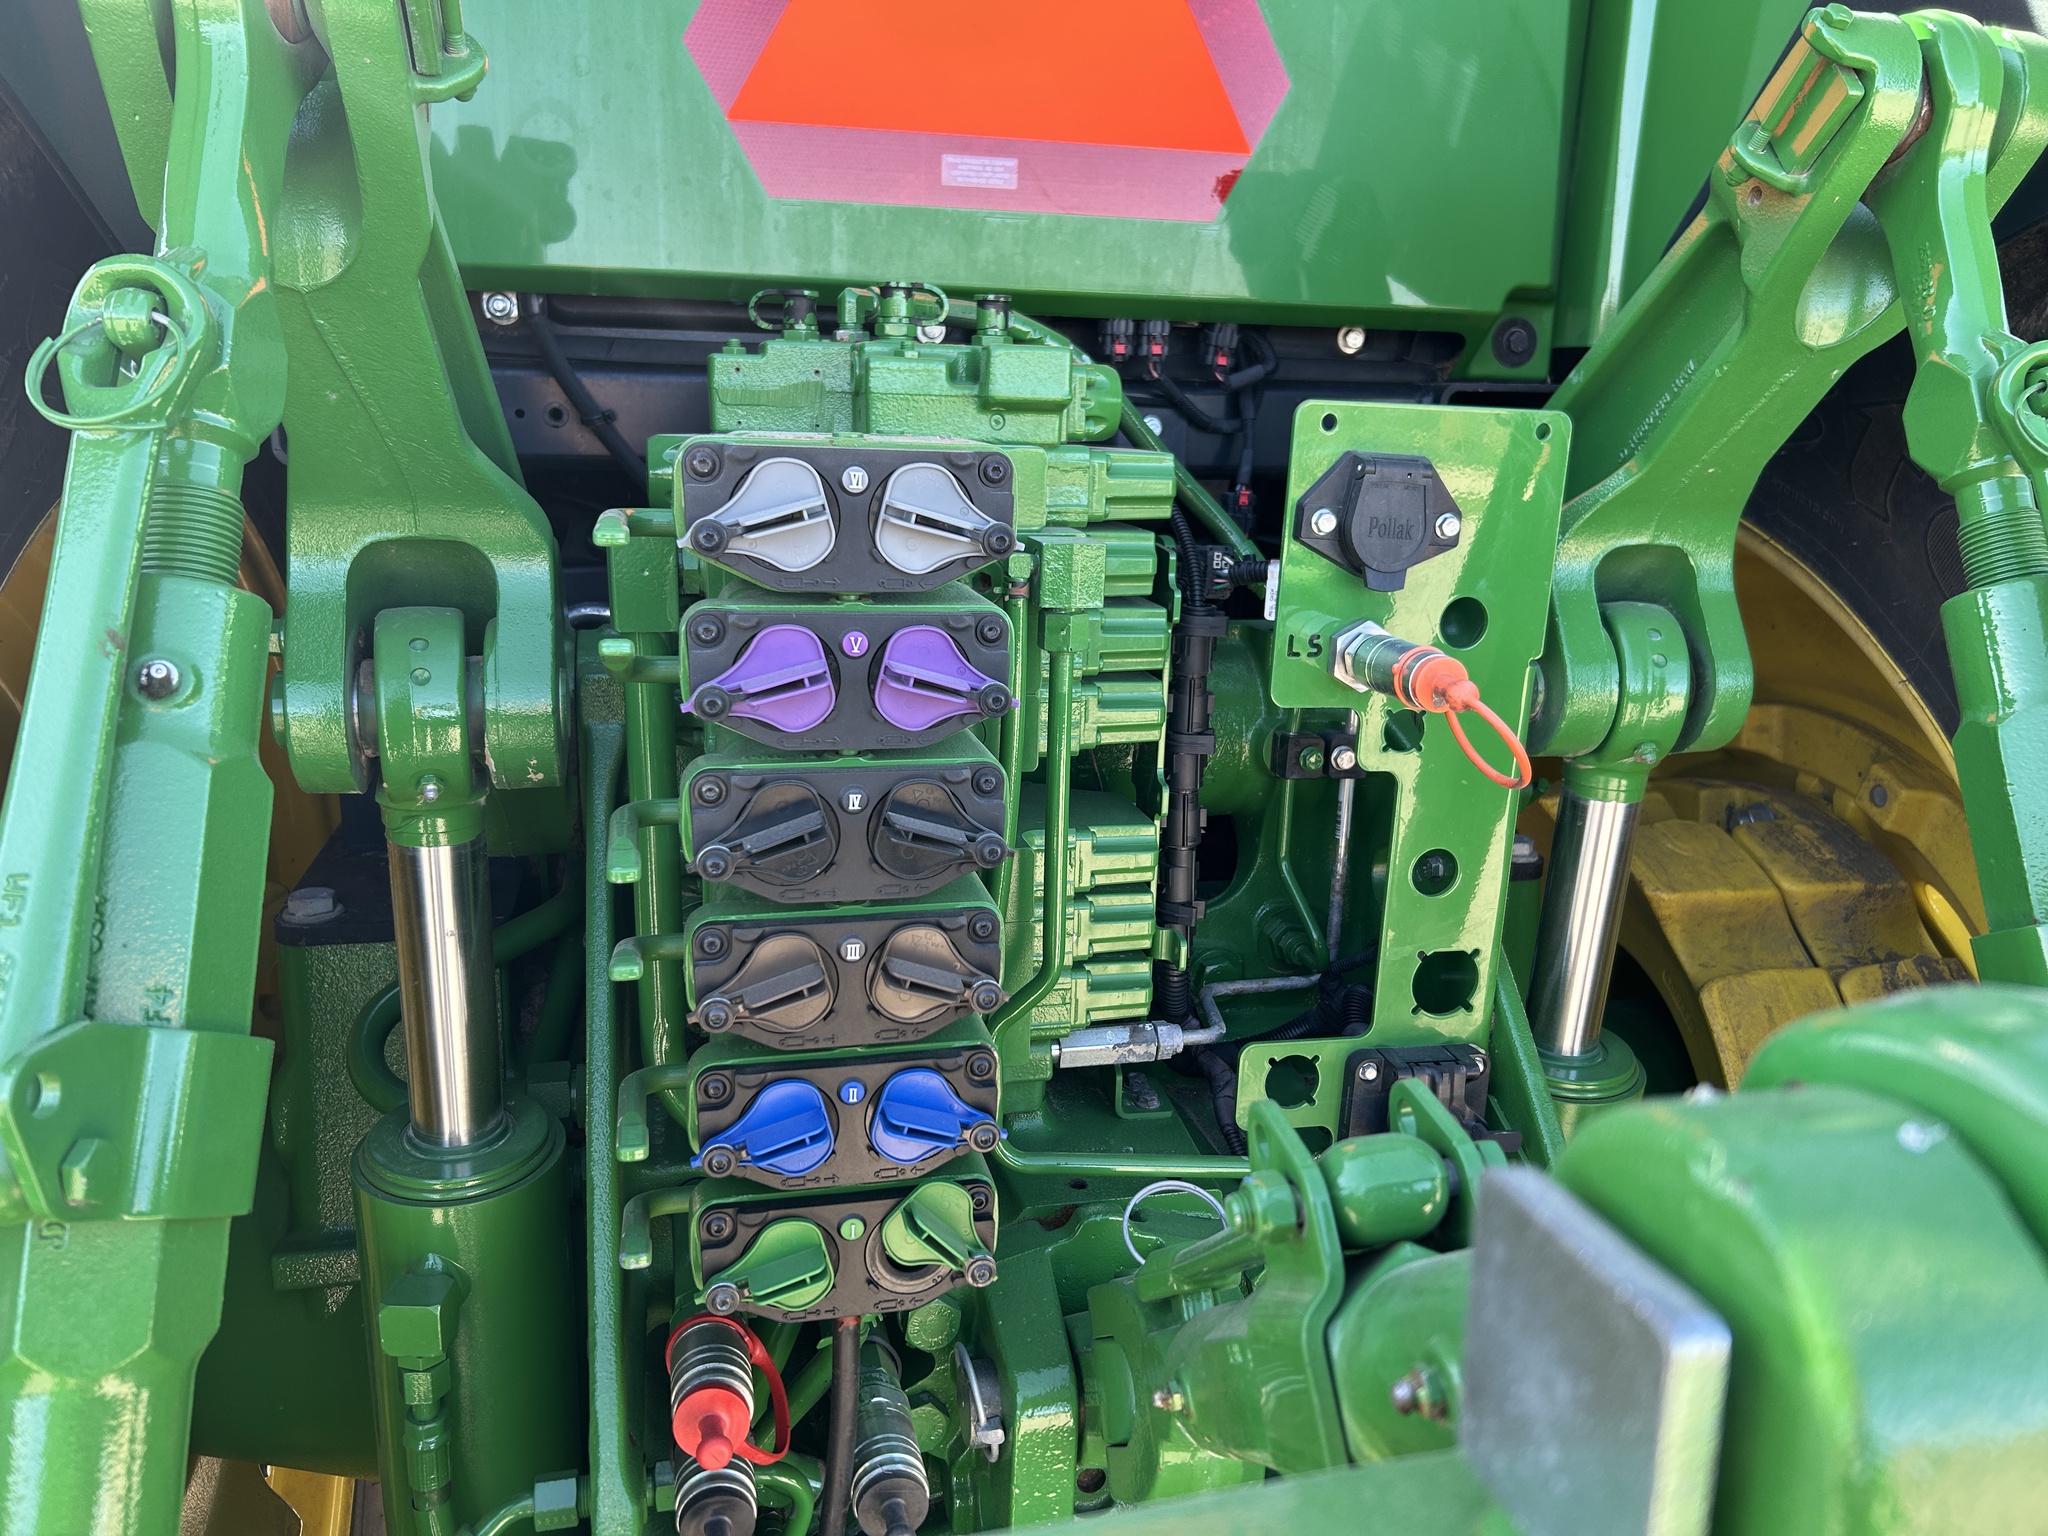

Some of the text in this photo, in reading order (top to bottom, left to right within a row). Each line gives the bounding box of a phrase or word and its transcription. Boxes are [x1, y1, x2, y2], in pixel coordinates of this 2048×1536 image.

[849, 472, 863, 488] VI
[1367, 515, 1414, 541] Pollak
[849, 637, 863, 653] V
[1287, 634, 1323, 658] LS
[848, 794, 862, 810] IV
[847, 944, 861, 959] III
[848, 1088, 858, 1102] II
[850, 1224, 856, 1239] I
